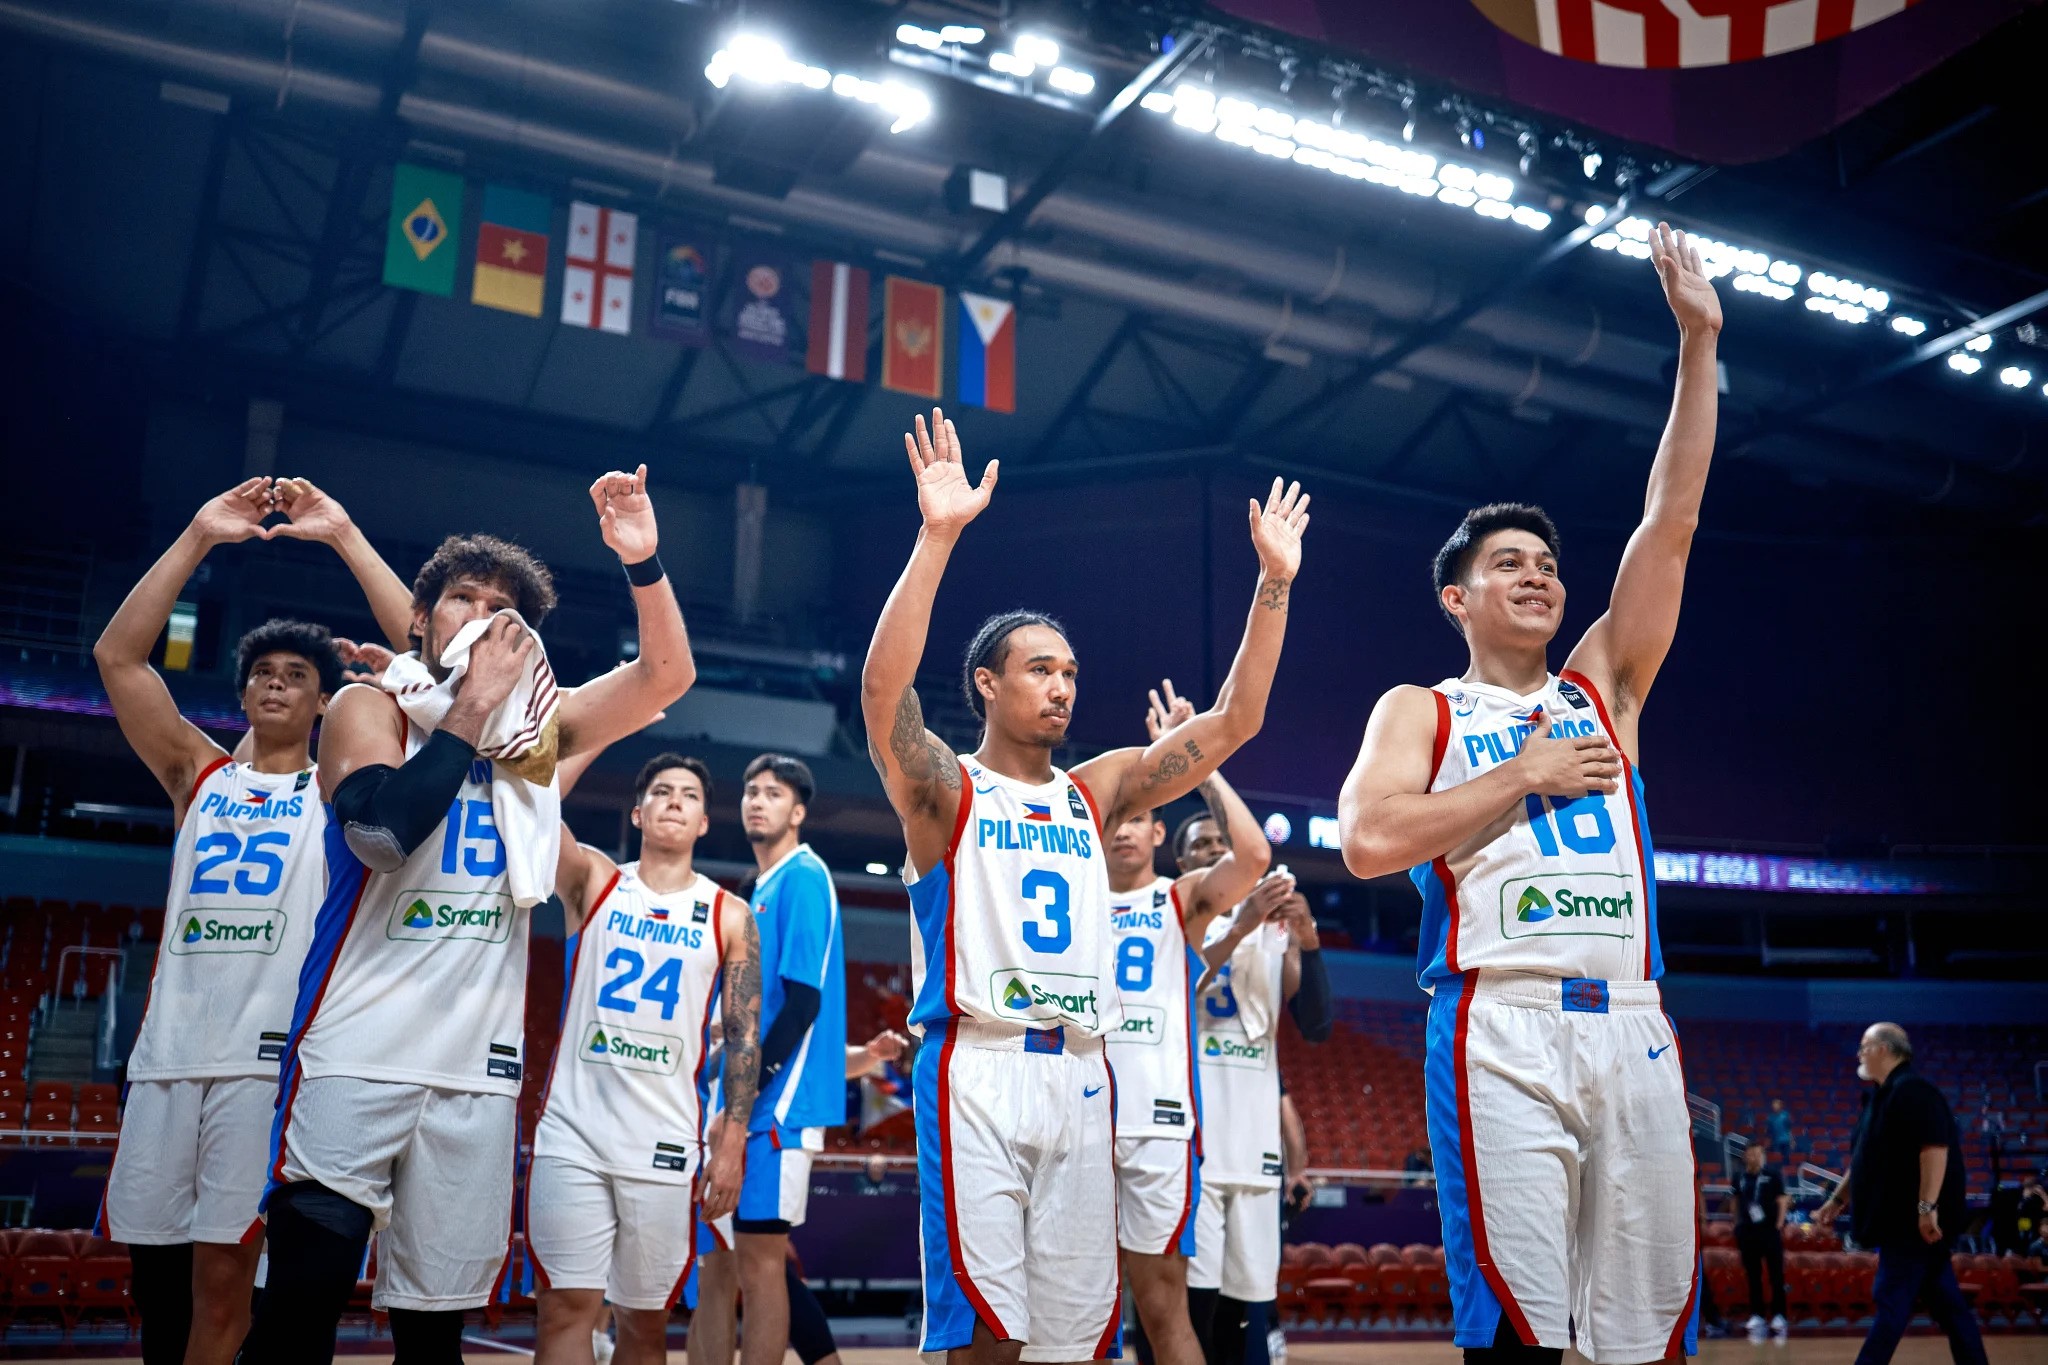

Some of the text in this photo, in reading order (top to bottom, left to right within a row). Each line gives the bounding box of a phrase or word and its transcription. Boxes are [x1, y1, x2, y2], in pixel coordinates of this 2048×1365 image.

[200, 792, 303, 820] PILIPINAS
[1525, 790, 1616, 857] 18
[441, 798, 507, 878] 15
[978, 818, 1092, 859] PILIPINAS
[189, 831, 291, 896] 25
[1703, 854, 1759, 886] 2024
[435, 904, 502, 929] Smart
[1021, 868, 1072, 954] 3
[1555, 889, 1632, 919] Smart
[204, 919, 274, 941] Smart
[606, 910, 703, 949] PILIPINAS
[597, 947, 683, 1020] 24
[1116, 936, 1155, 992] 8
[1031, 984, 1097, 1014] Smart
[1206, 963, 1238, 1018] 3
[1121, 1016, 1153, 1034] art
[610, 1036, 670, 1064] Smart
